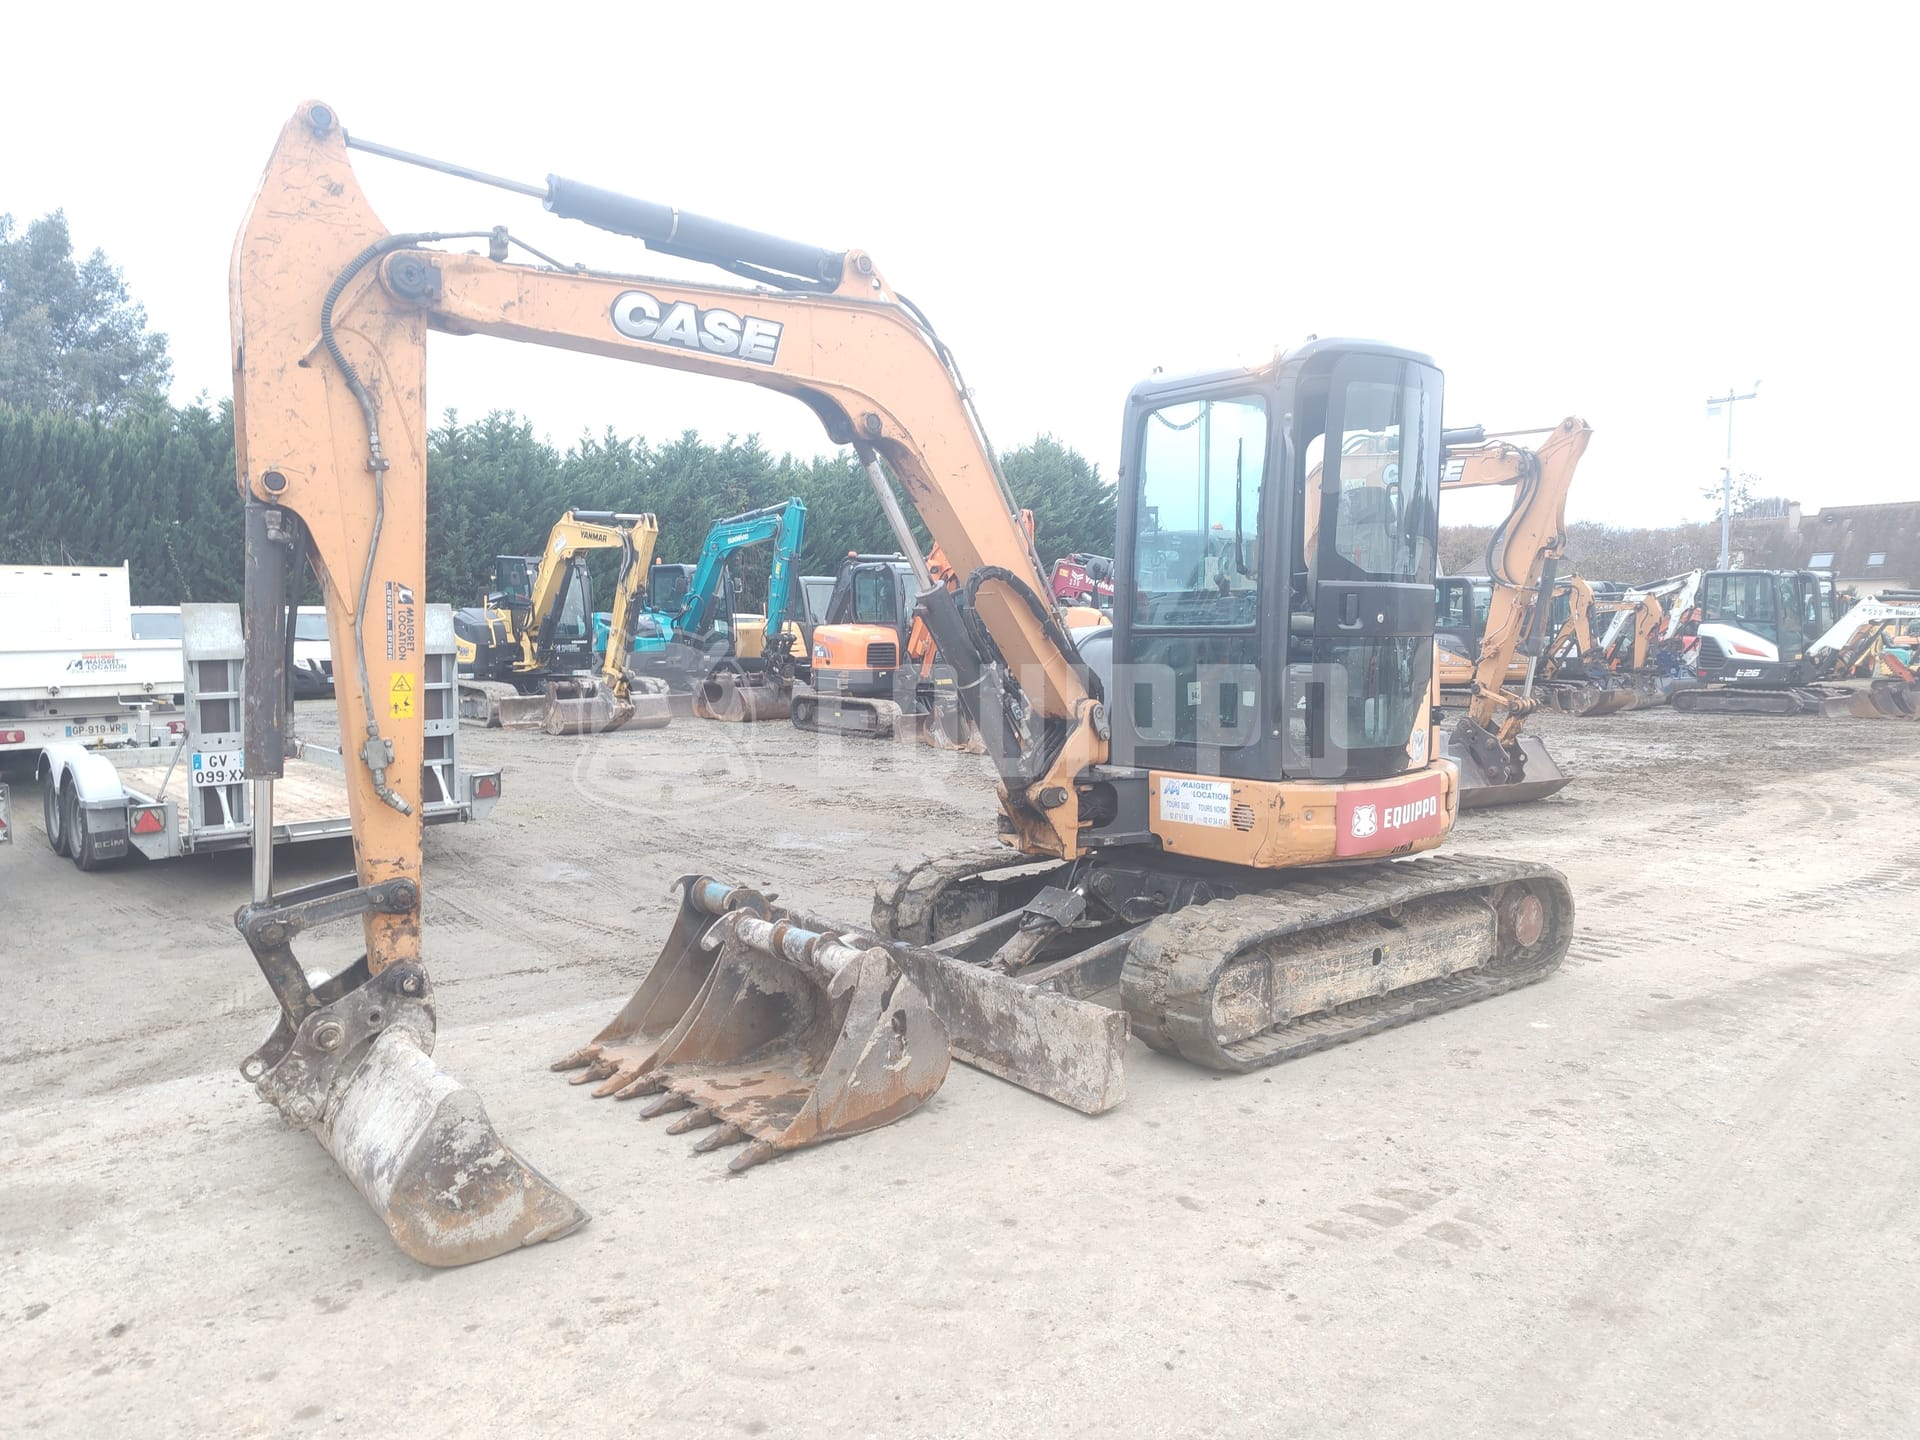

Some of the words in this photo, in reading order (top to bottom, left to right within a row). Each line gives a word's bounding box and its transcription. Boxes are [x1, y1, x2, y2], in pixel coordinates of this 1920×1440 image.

[612, 291, 784, 366] CASE
[580, 531, 608, 544] YANMAR
[398, 610, 407, 661] LOCATION
[406, 607, 415, 652] MAIGRET
[1180, 781, 1213, 791] MAIGRET
[1192, 790, 1229, 801] LOCATION
[1383, 796, 1437, 829] EQUIPPO
